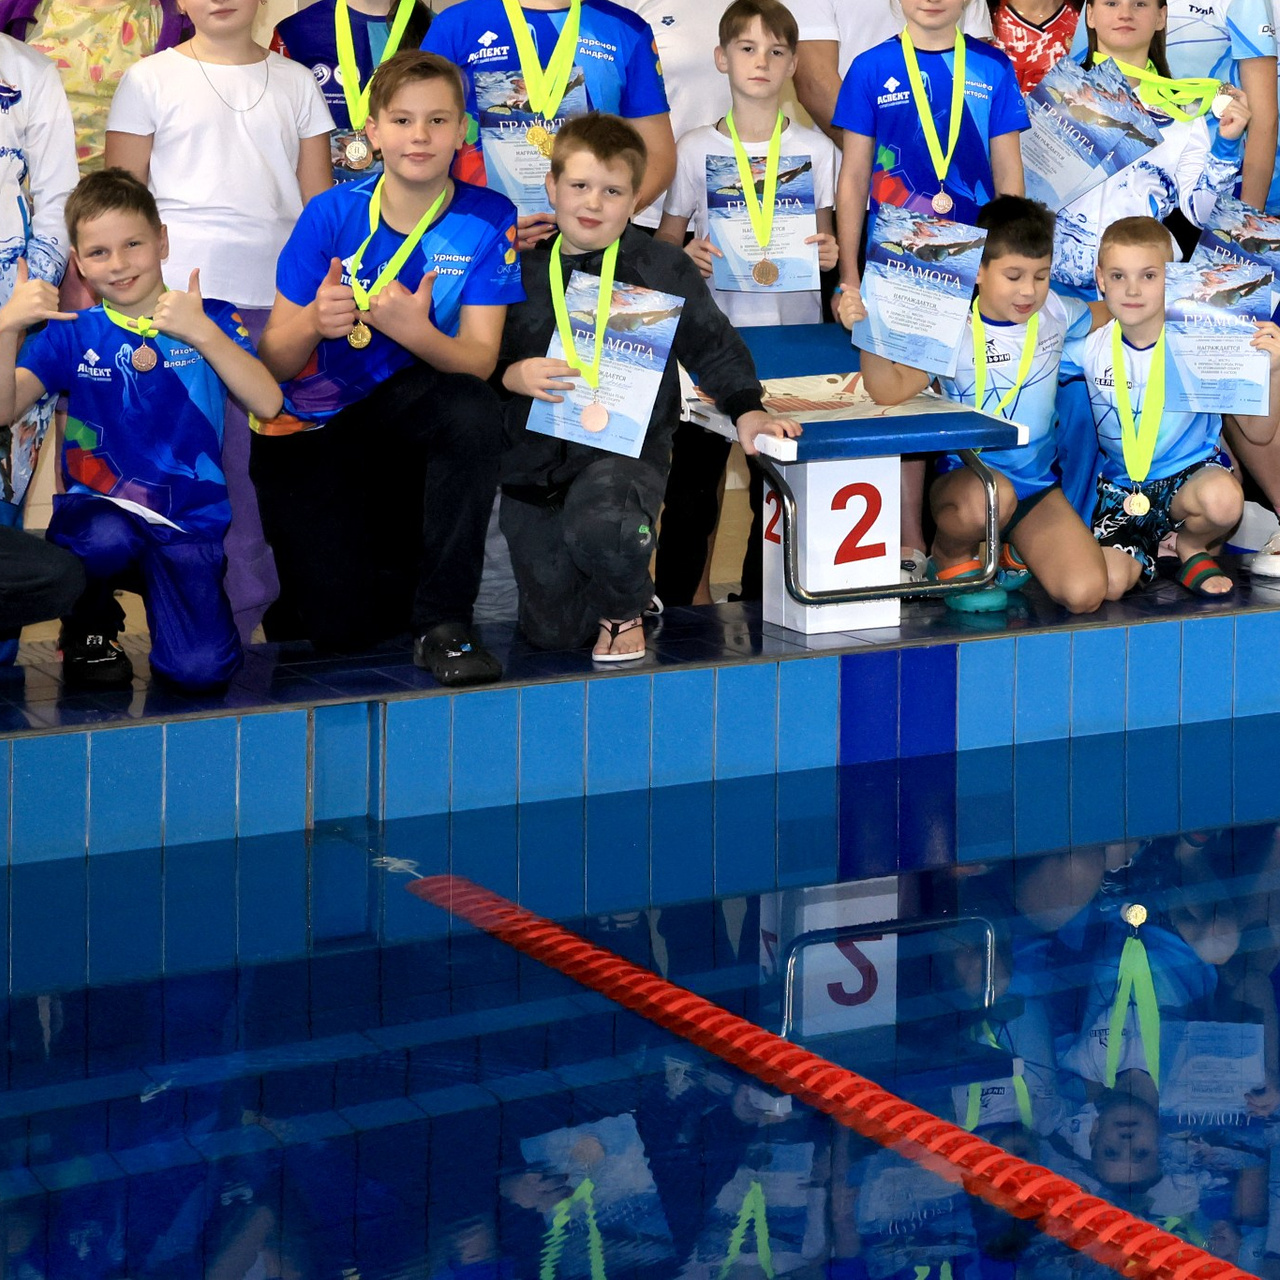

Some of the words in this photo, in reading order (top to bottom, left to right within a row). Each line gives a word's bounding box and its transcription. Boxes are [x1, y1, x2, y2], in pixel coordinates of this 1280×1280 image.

[580, 47, 615, 62] Андрей
[877, 91, 910, 105] АСПЕКТ
[499, 118, 573, 134] ГРАМОТ
[1039, 101, 1096, 156] ГРАМОТА
[430, 252, 474, 264] урначе
[886, 258, 962, 290] ГРАМОТА
[1183, 314, 1258, 327] ГРАМОТА
[574, 328, 655, 360] ГРМОТА
[170, 347, 198, 357] Тихон
[972, 352, 1011, 365] ЬФИН
[1094, 377, 1133, 389] ДЕЛЬН
[765, 489, 781, 545] 2
[831, 482, 886, 565] 2
